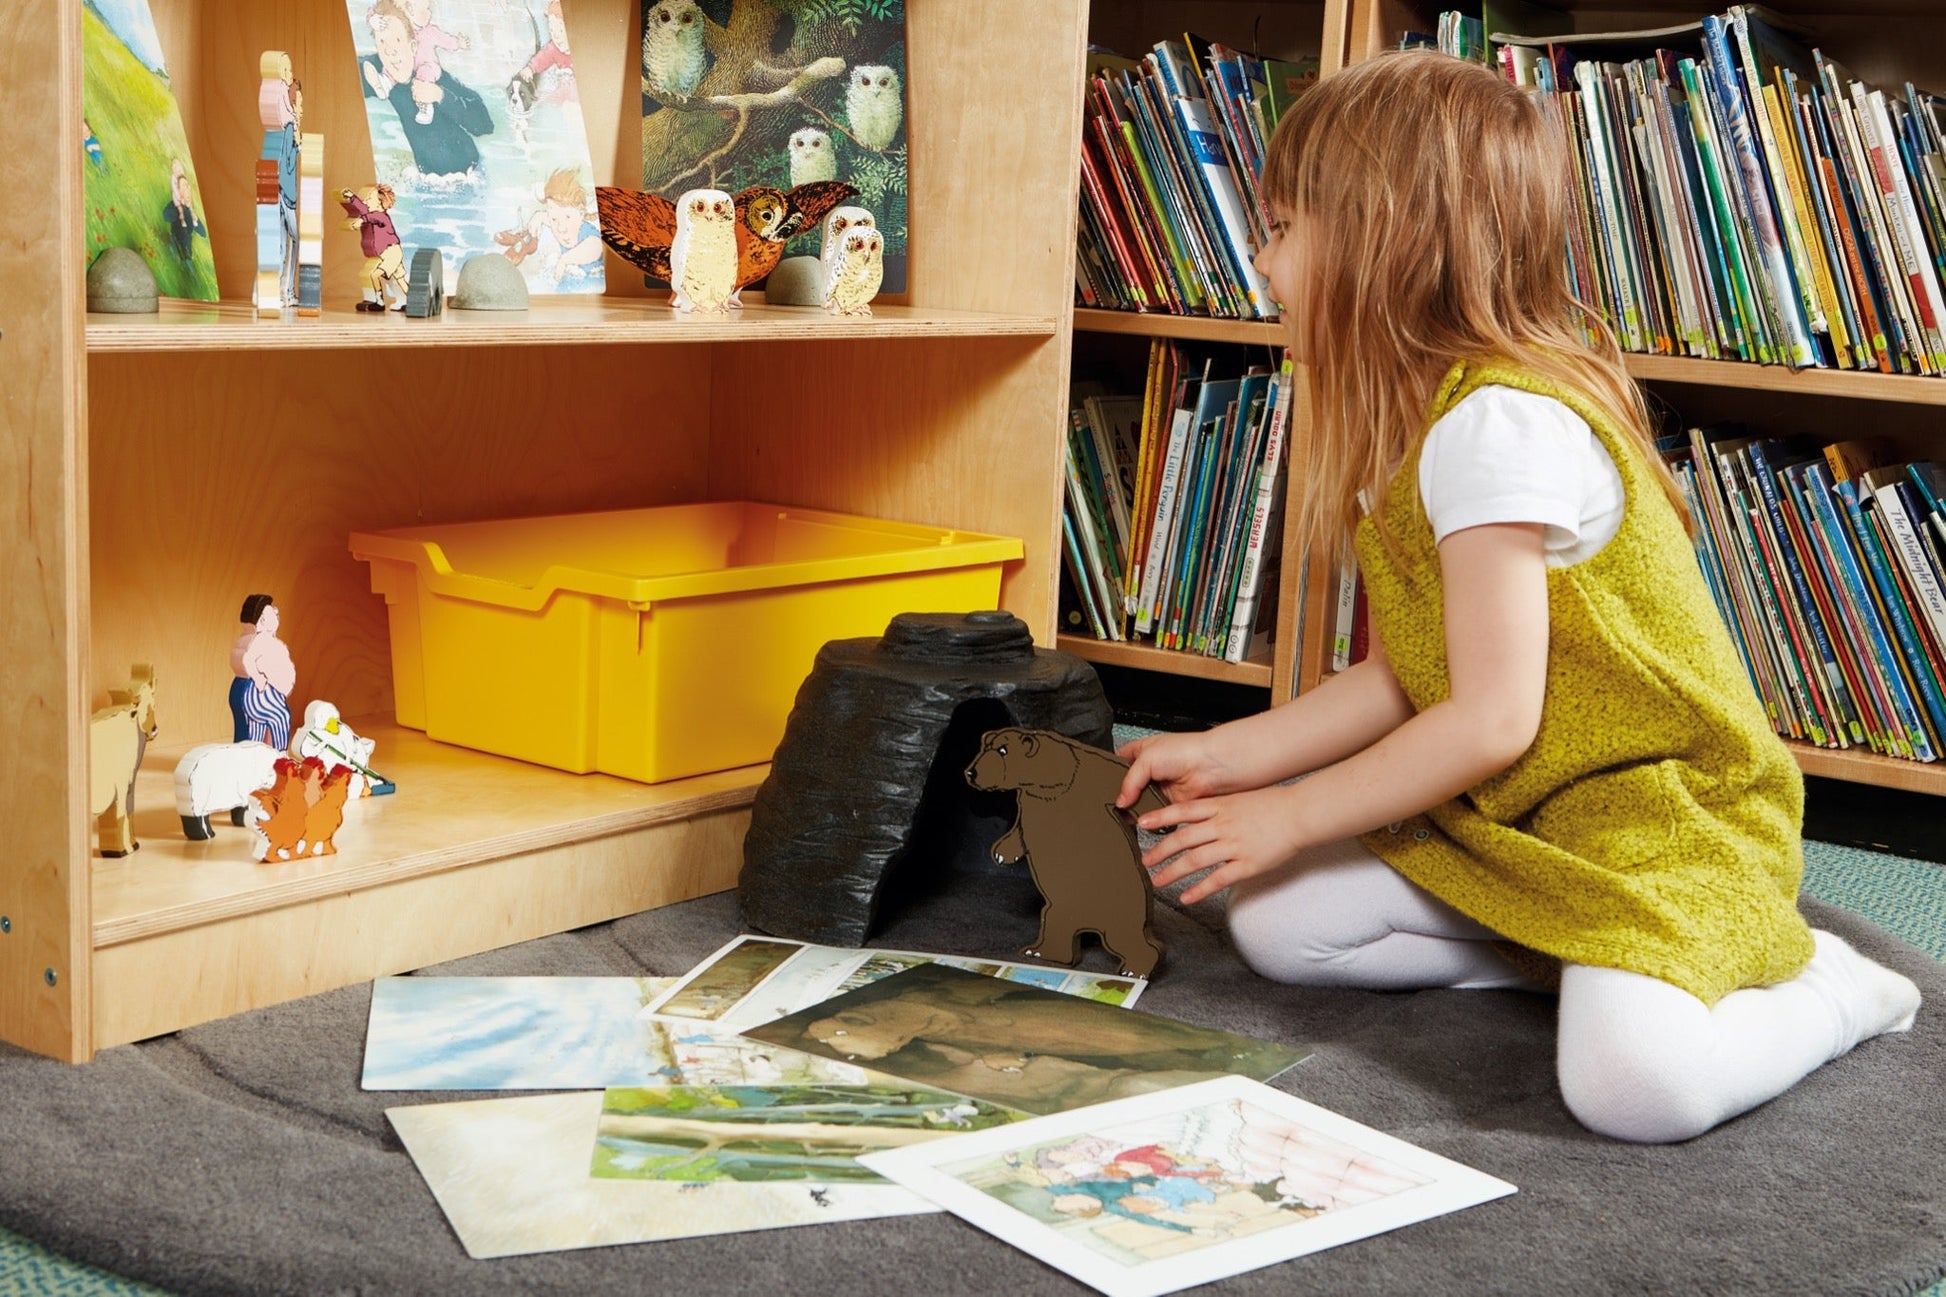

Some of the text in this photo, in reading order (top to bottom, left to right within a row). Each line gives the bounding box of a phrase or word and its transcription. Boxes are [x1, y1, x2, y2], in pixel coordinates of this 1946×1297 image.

[1708, 26, 1717, 38] The
[1745, 58, 1753, 68] to
[1747, 68, 1757, 83] the
[1855, 94, 1867, 113] Emily
[1886, 143, 1898, 167] HOOT
[1886, 196, 1904, 232] Monkey
[1903, 250, 1915, 269] ME
[1842, 227, 1867, 295] OSCAR and the MOTH
[1266, 409, 1283, 461] ELYS DOLAN
[1164, 455, 1179, 482] Little
[1753, 456, 1764, 471] THE
[1154, 483, 1173, 522] Penguin
[1889, 507, 1908, 530] The
[1250, 506, 1265, 549] WEASELS
[1860, 534, 1874, 552] Love
[1867, 551, 1882, 572] You!
[1895, 529, 1934, 589] Midnight
[1343, 579, 1352, 608] Palin
[1793, 570, 1811, 602] Donaldson
[1924, 585, 1946, 617] Bear
[1886, 594, 1910, 643] Ian Whybrow
[1911, 658, 1925, 679] Rosie
[1919, 678, 1934, 702] Reeve
